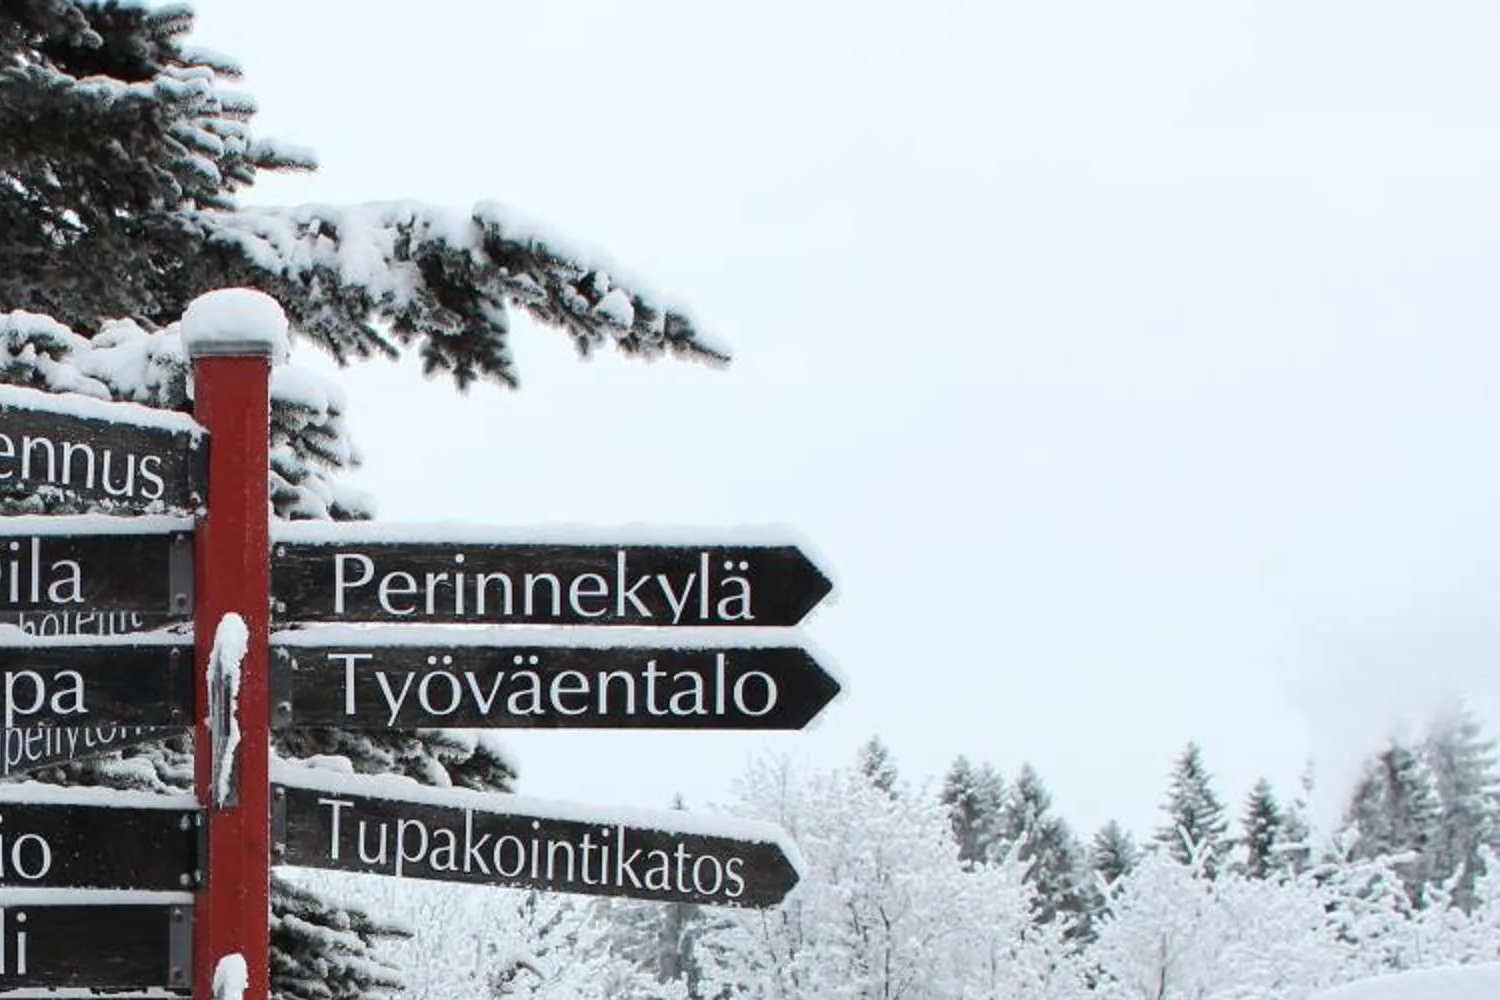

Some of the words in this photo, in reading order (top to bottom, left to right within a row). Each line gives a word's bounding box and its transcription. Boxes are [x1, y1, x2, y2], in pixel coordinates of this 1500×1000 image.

[334, 550, 756, 625] Perinnekylä
[327, 653, 778, 727] Työväentalo
[318, 797, 746, 899] Tupakointikatos
